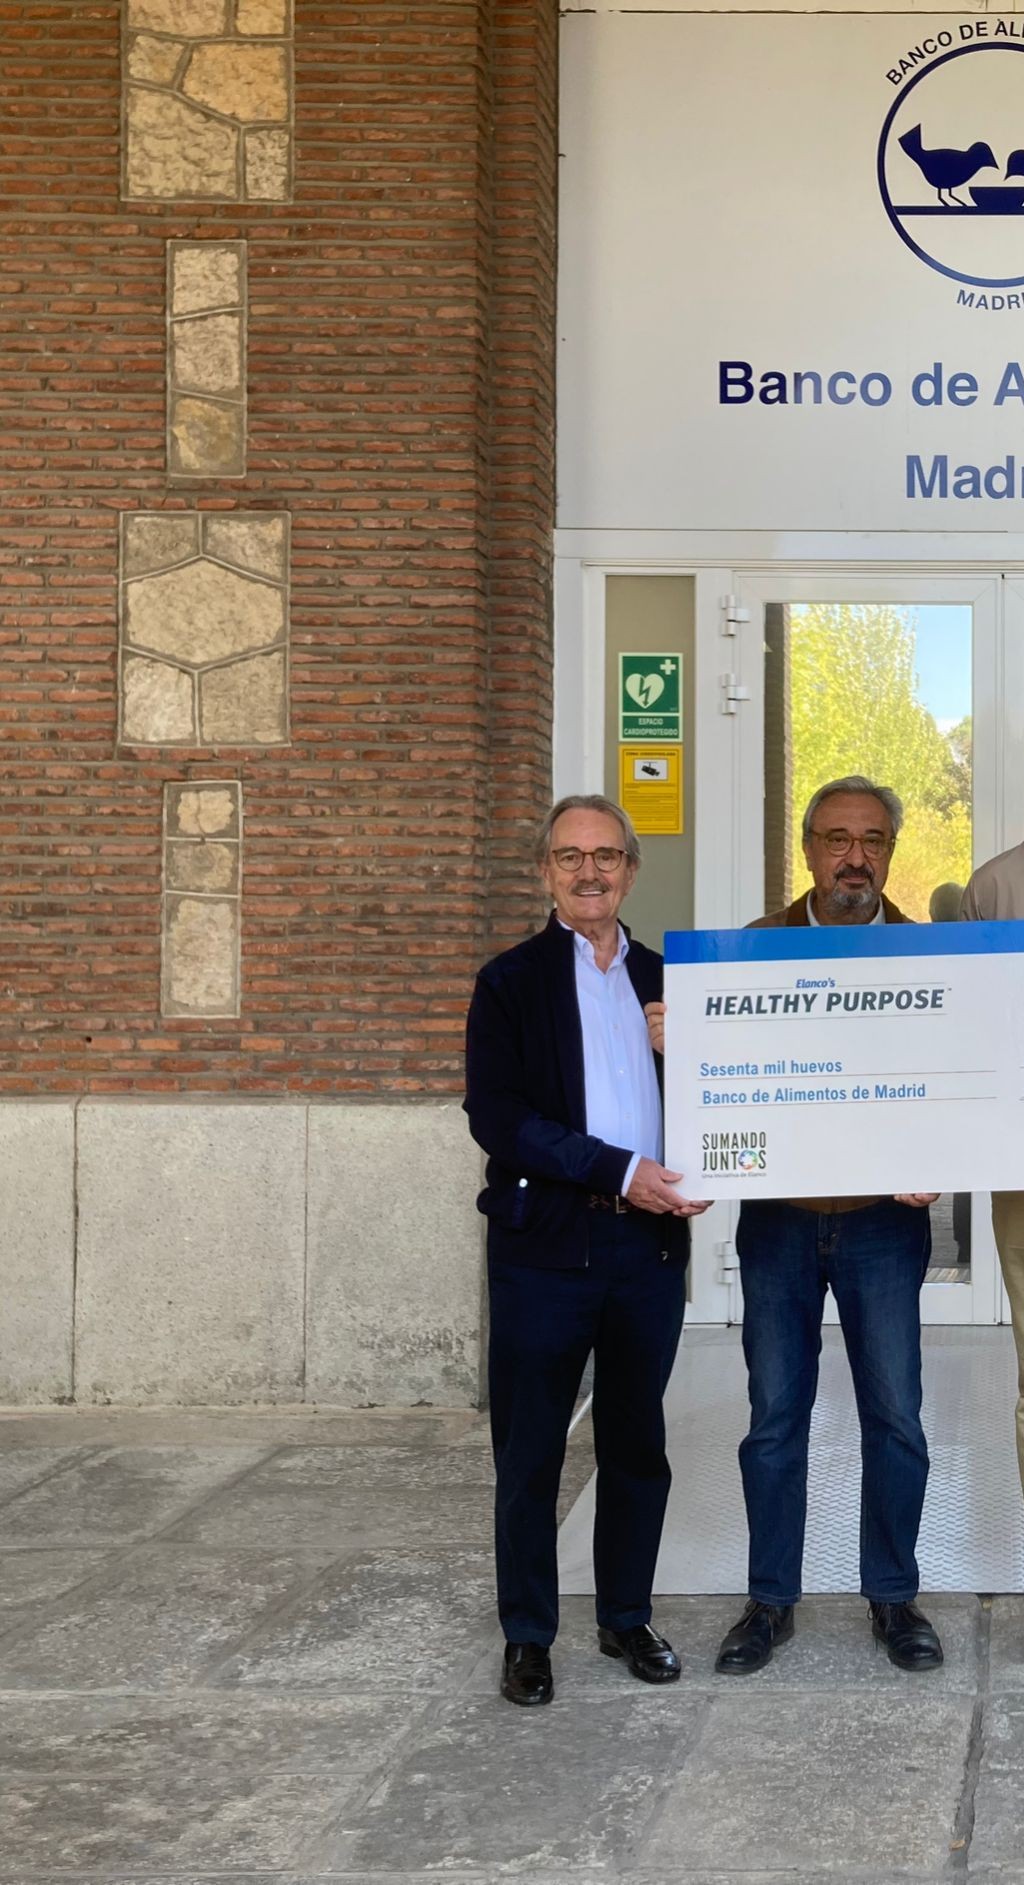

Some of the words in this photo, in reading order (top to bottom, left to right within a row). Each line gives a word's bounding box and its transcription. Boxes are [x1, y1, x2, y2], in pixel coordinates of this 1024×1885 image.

[886, 31, 953, 85] BANCO
[959, 21, 988, 40] DE
[718, 361, 892, 405] Banco
[911, 362, 979, 406] de
[638, 718, 664, 726] ESPACIO
[624, 728, 678, 736] CARDIOPROTEGIDO
[796, 978, 836, 988] Elanco's
[705, 993, 818, 1016] HEALTHY
[826, 989, 945, 1012] PURPOSE
[700, 1062, 759, 1077] Sesenta
[764, 1060, 785, 1074] mil
[791, 1060, 842, 1074] huevos
[703, 1090, 747, 1104] Banco
[752, 1089, 770, 1102] de
[774, 1087, 847, 1101] Alimentos
[852, 1086, 869, 1099] de
[875, 1084, 926, 1098] Madrid
[702, 1132, 767, 1150] SUMANDO
[702, 1150, 767, 1171] JUNTOS
